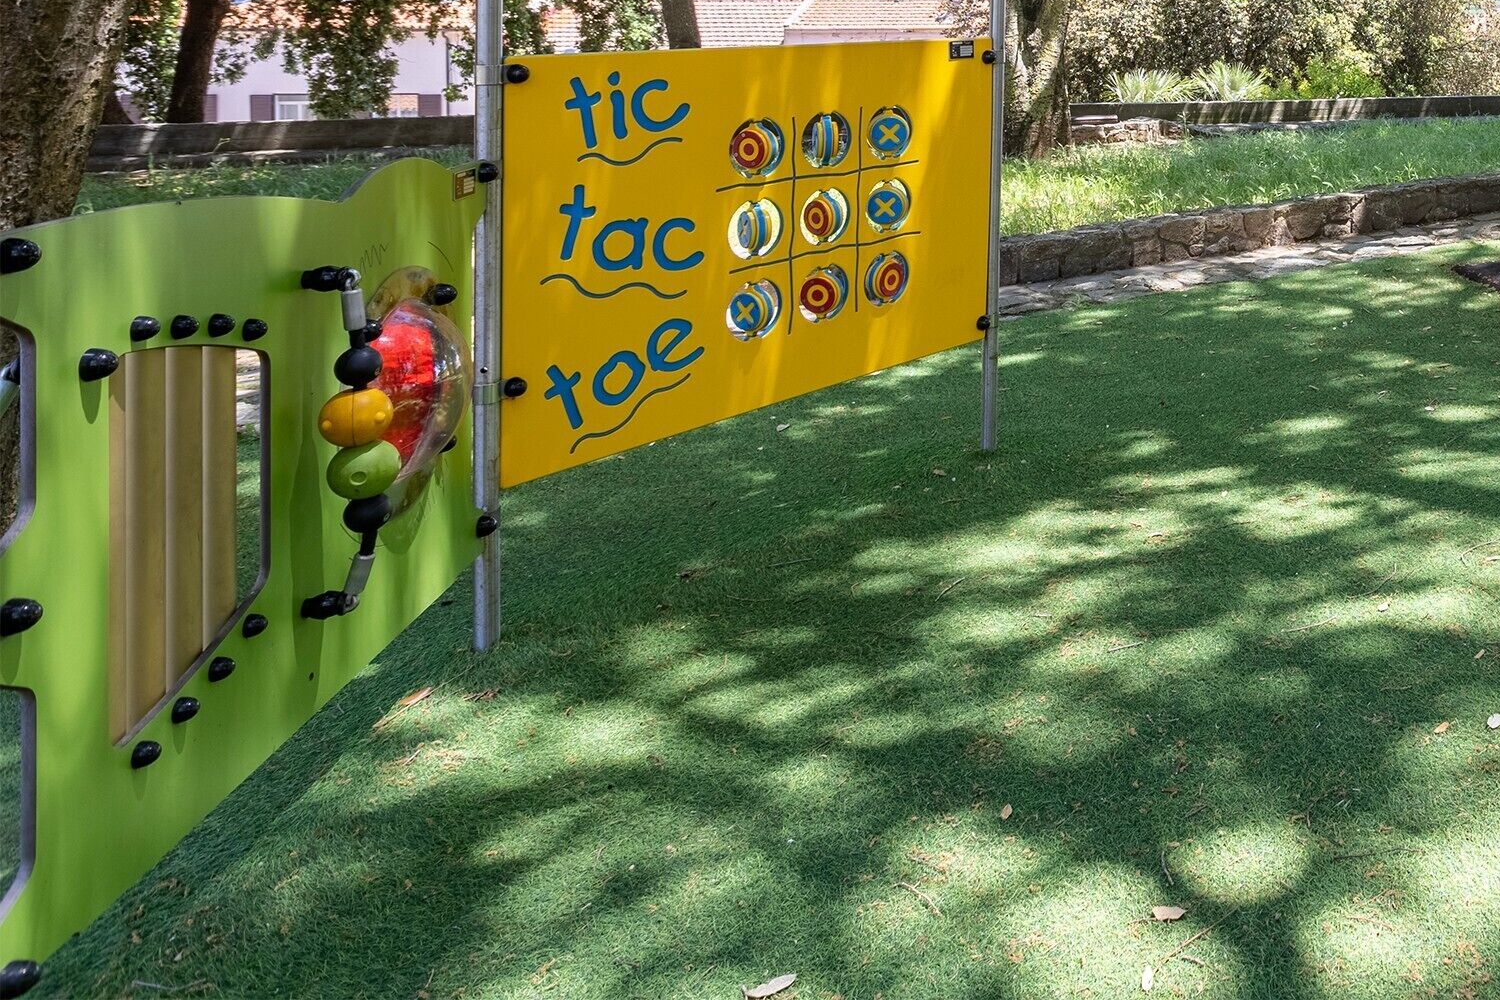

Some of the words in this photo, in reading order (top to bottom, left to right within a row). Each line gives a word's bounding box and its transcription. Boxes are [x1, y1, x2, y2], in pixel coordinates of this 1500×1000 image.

[565, 71, 690, 148] tic
[560, 185, 704, 271] tac
[544, 318, 704, 429] toe
